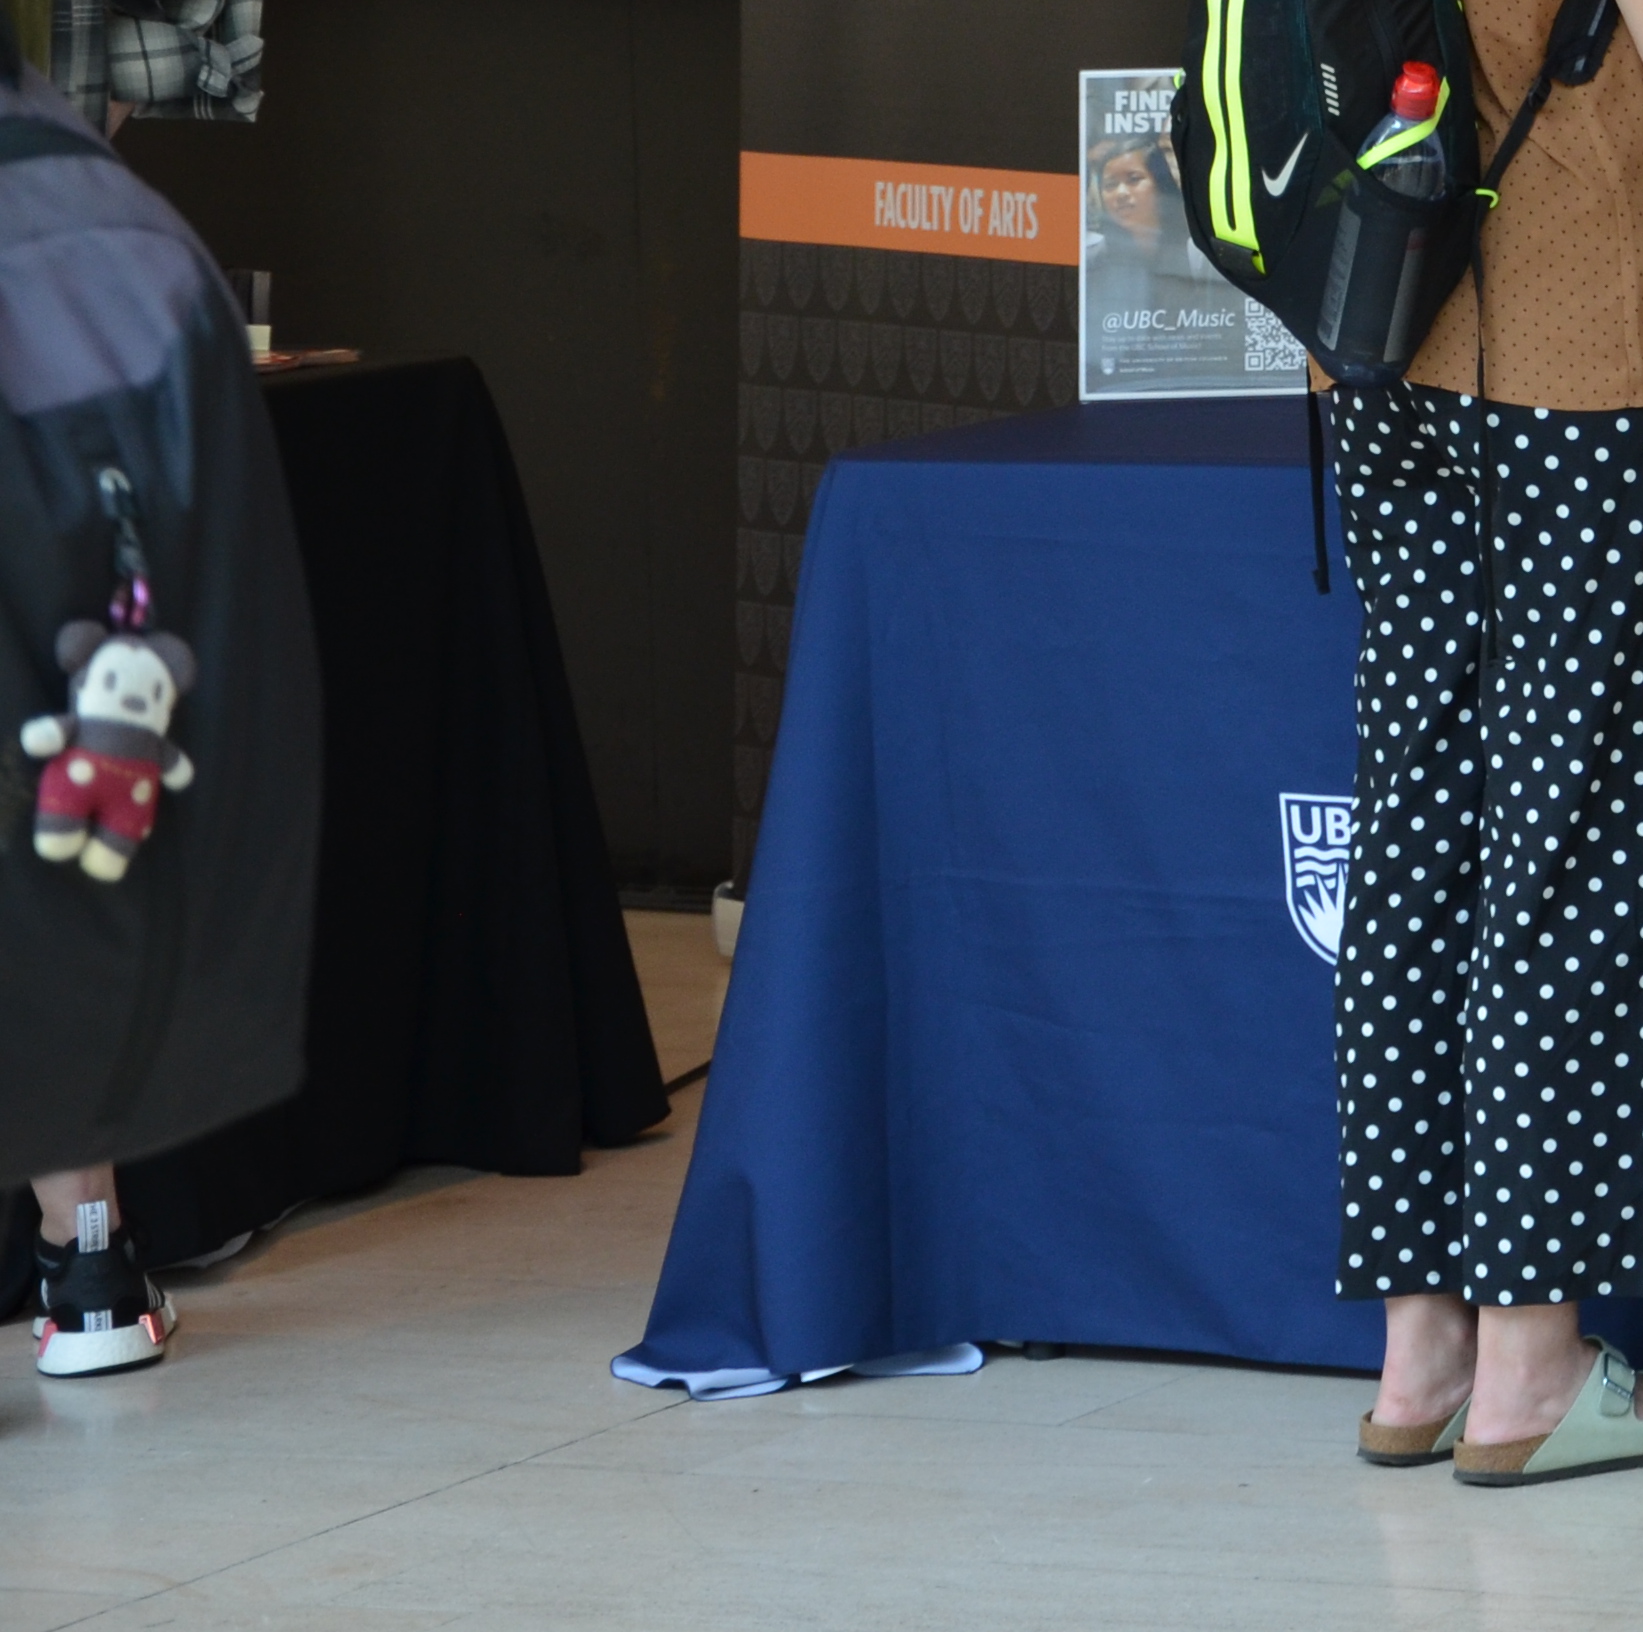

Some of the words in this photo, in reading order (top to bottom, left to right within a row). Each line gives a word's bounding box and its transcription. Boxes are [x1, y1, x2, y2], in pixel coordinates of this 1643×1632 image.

[1115, 90, 1176, 111] FIND
[1105, 112, 1172, 134] INST
[874, 181, 952, 233] FACULTY
[958, 188, 984, 235] OF
[989, 190, 1039, 240] ARTS
[1102, 308, 1236, 334] @UBC_Music
[1290, 804, 1351, 845] UB
